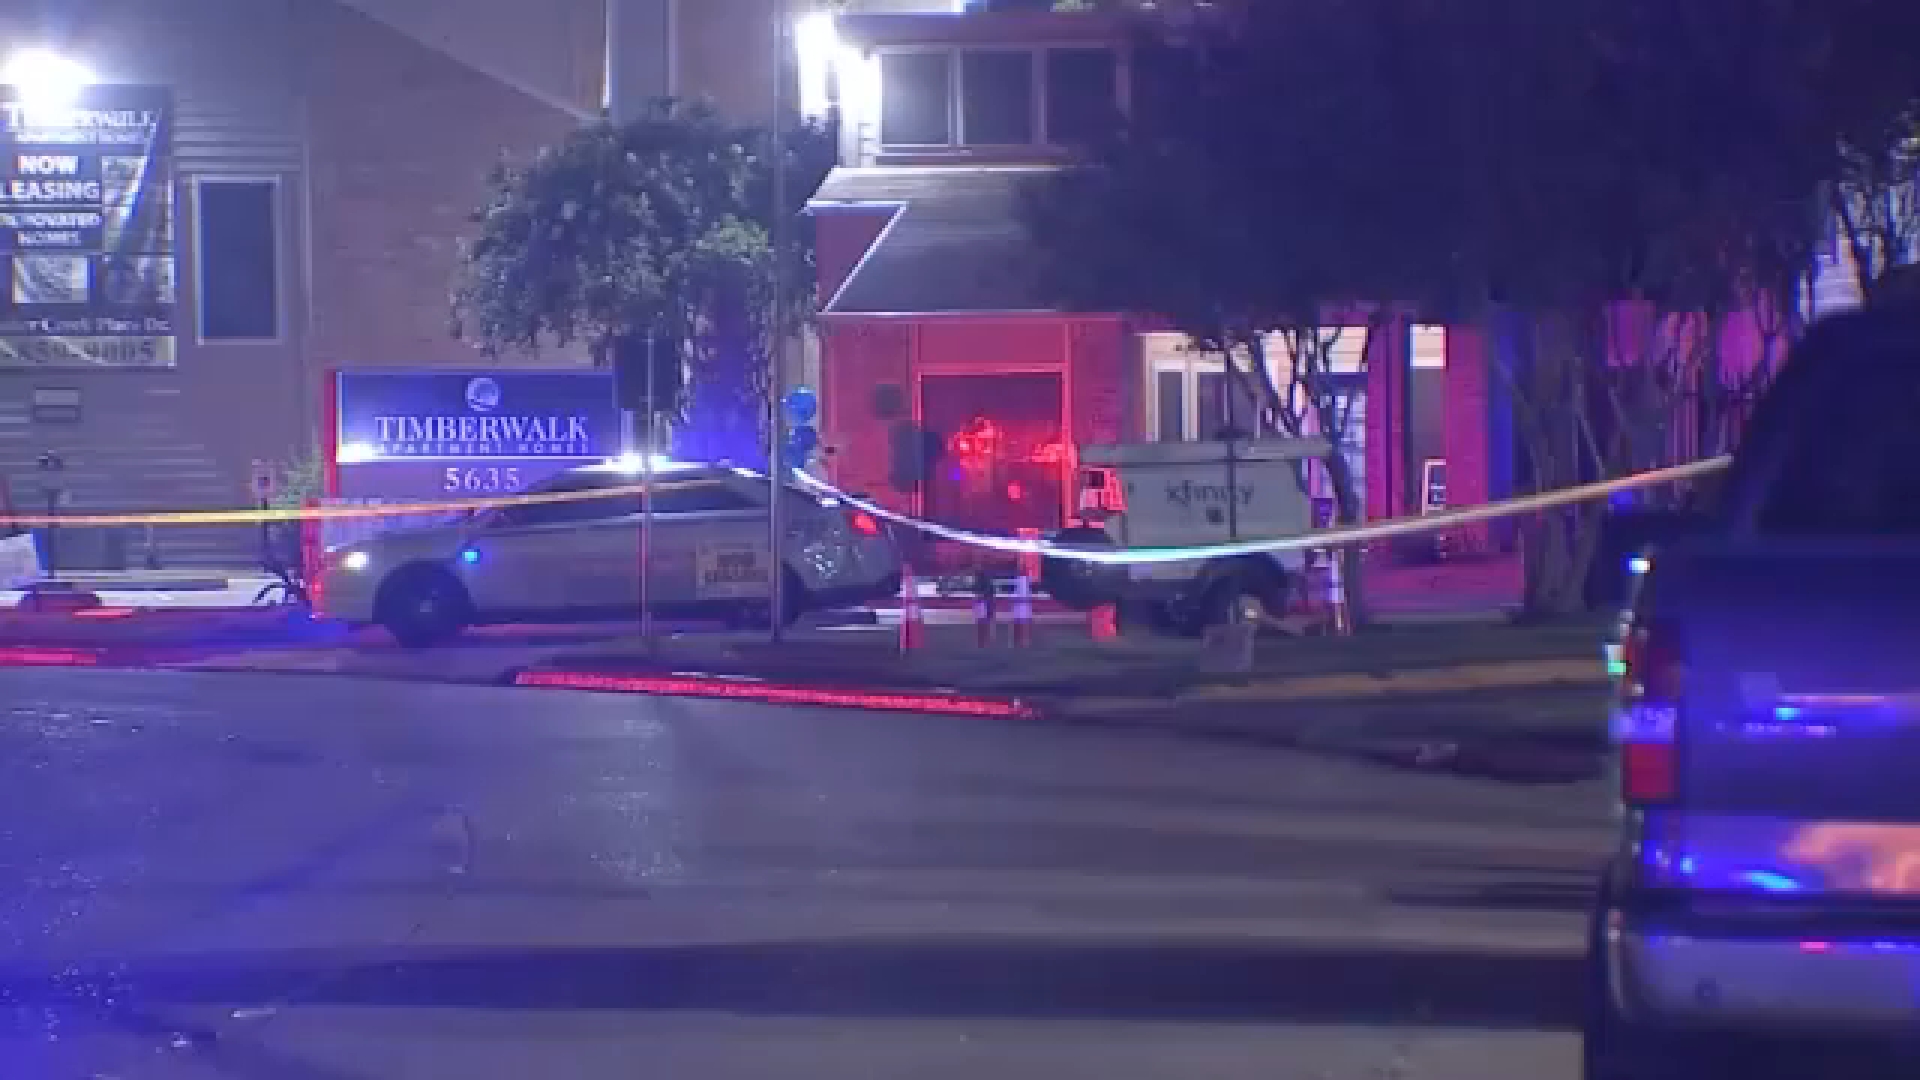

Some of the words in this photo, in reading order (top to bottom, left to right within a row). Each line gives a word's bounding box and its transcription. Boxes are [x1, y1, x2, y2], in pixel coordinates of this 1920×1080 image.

[18, 155, 79, 175] NOW
[0, 183, 99, 201] LEASING
[375, 415, 589, 442] TIMBERWALK
[518, 442, 588, 454] HOMES
[443, 467, 520, 491] 5635
